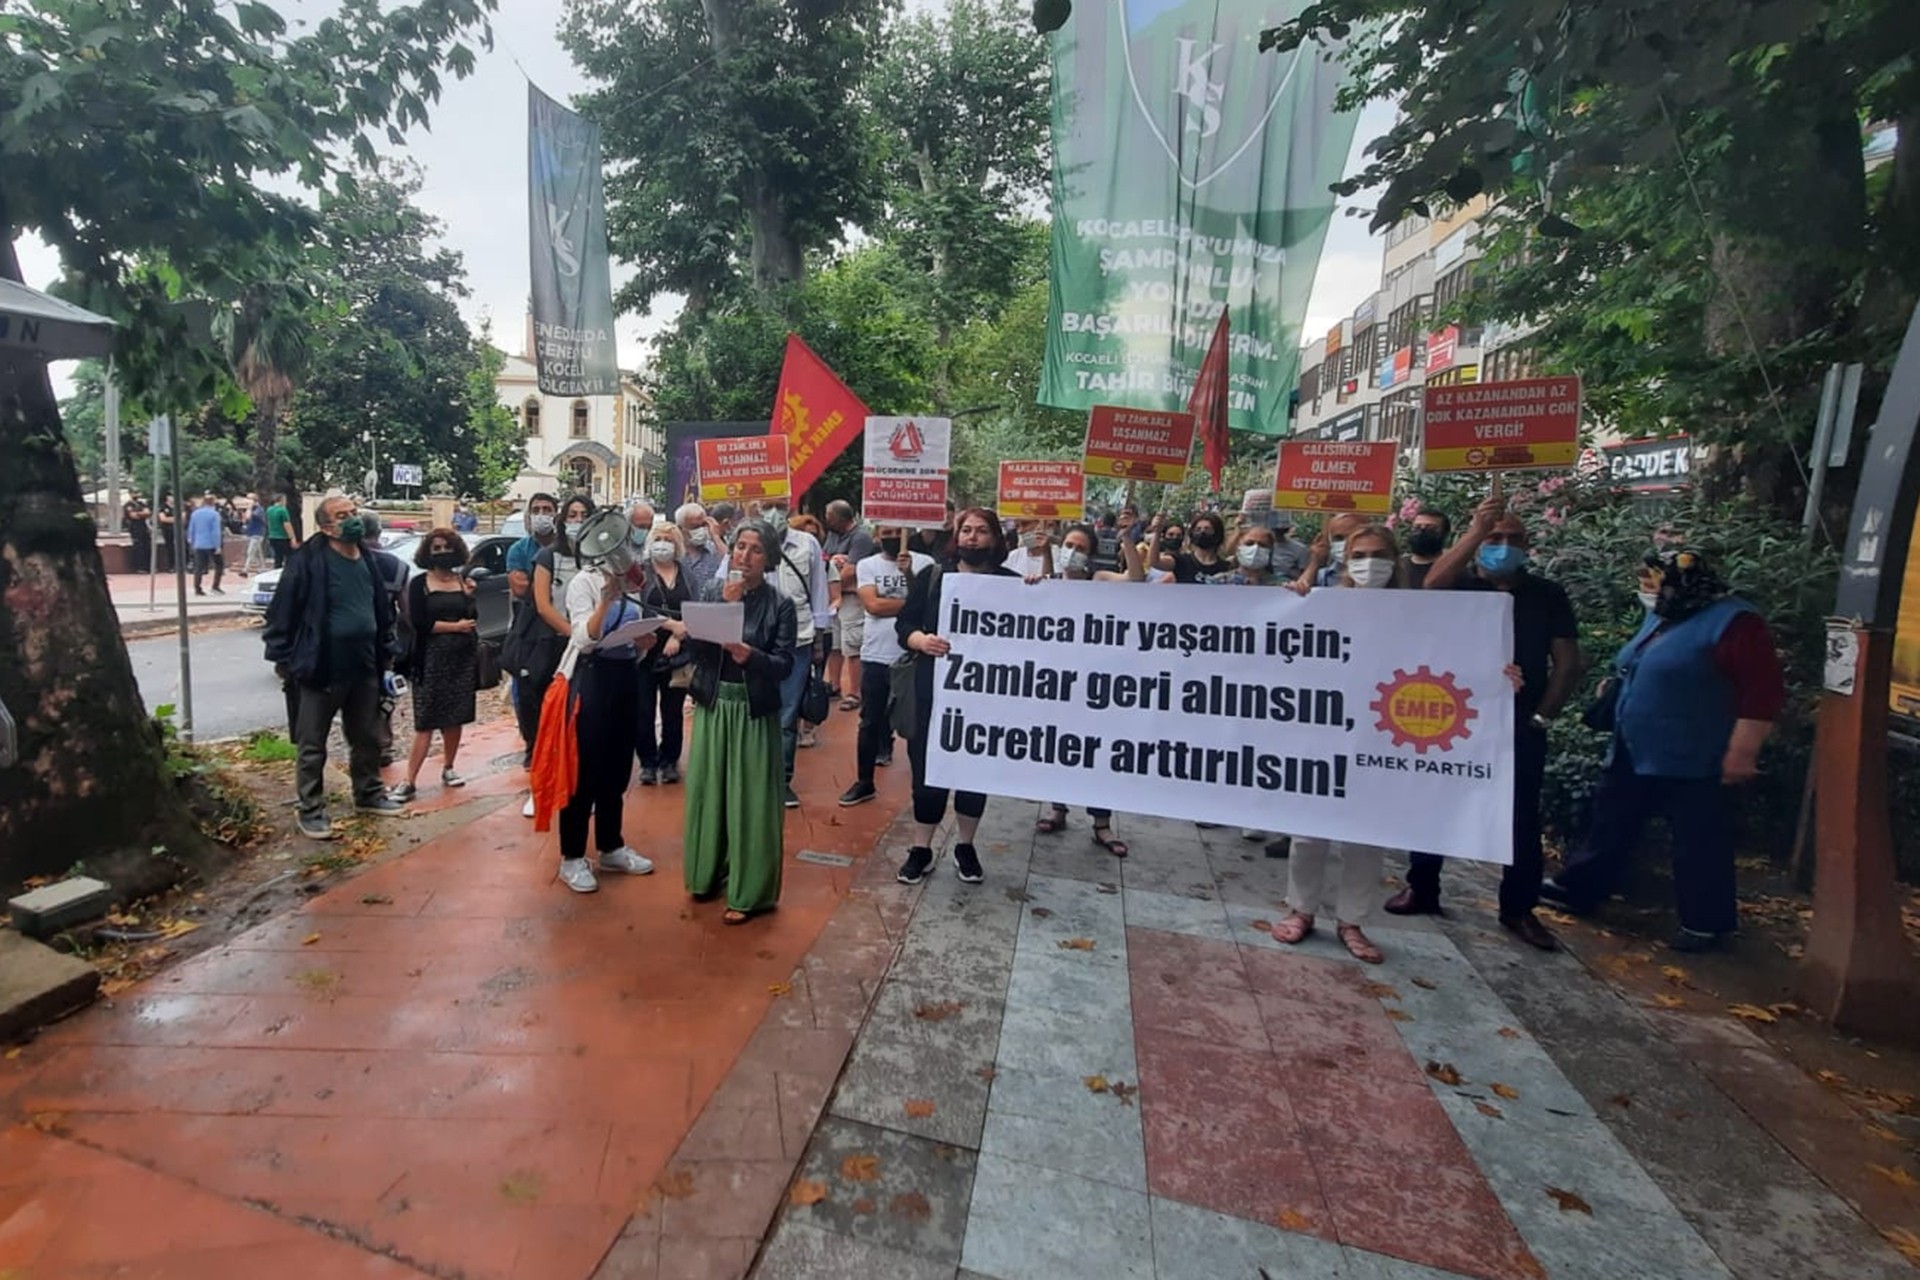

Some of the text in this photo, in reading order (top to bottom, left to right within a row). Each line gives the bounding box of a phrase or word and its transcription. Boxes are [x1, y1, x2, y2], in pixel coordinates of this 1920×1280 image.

[1076, 367, 1155, 391] TAHİR
[1436, 384, 1568, 405] AZ KAZANANDAN AZ
[1456, 405, 1545, 421] KAZANANDAN
[1474, 421, 1525, 439] VERGİ!
[949, 598, 1351, 663] İnsanca bir yaşam için;
[943, 653, 1355, 731] Zamlar geri alınsın,
[1394, 698, 1455, 721] EMEP
[940, 707, 1347, 798] Ücretler arttırılsın!
[1355, 753, 1492, 779] EMEK PARTİSİ
